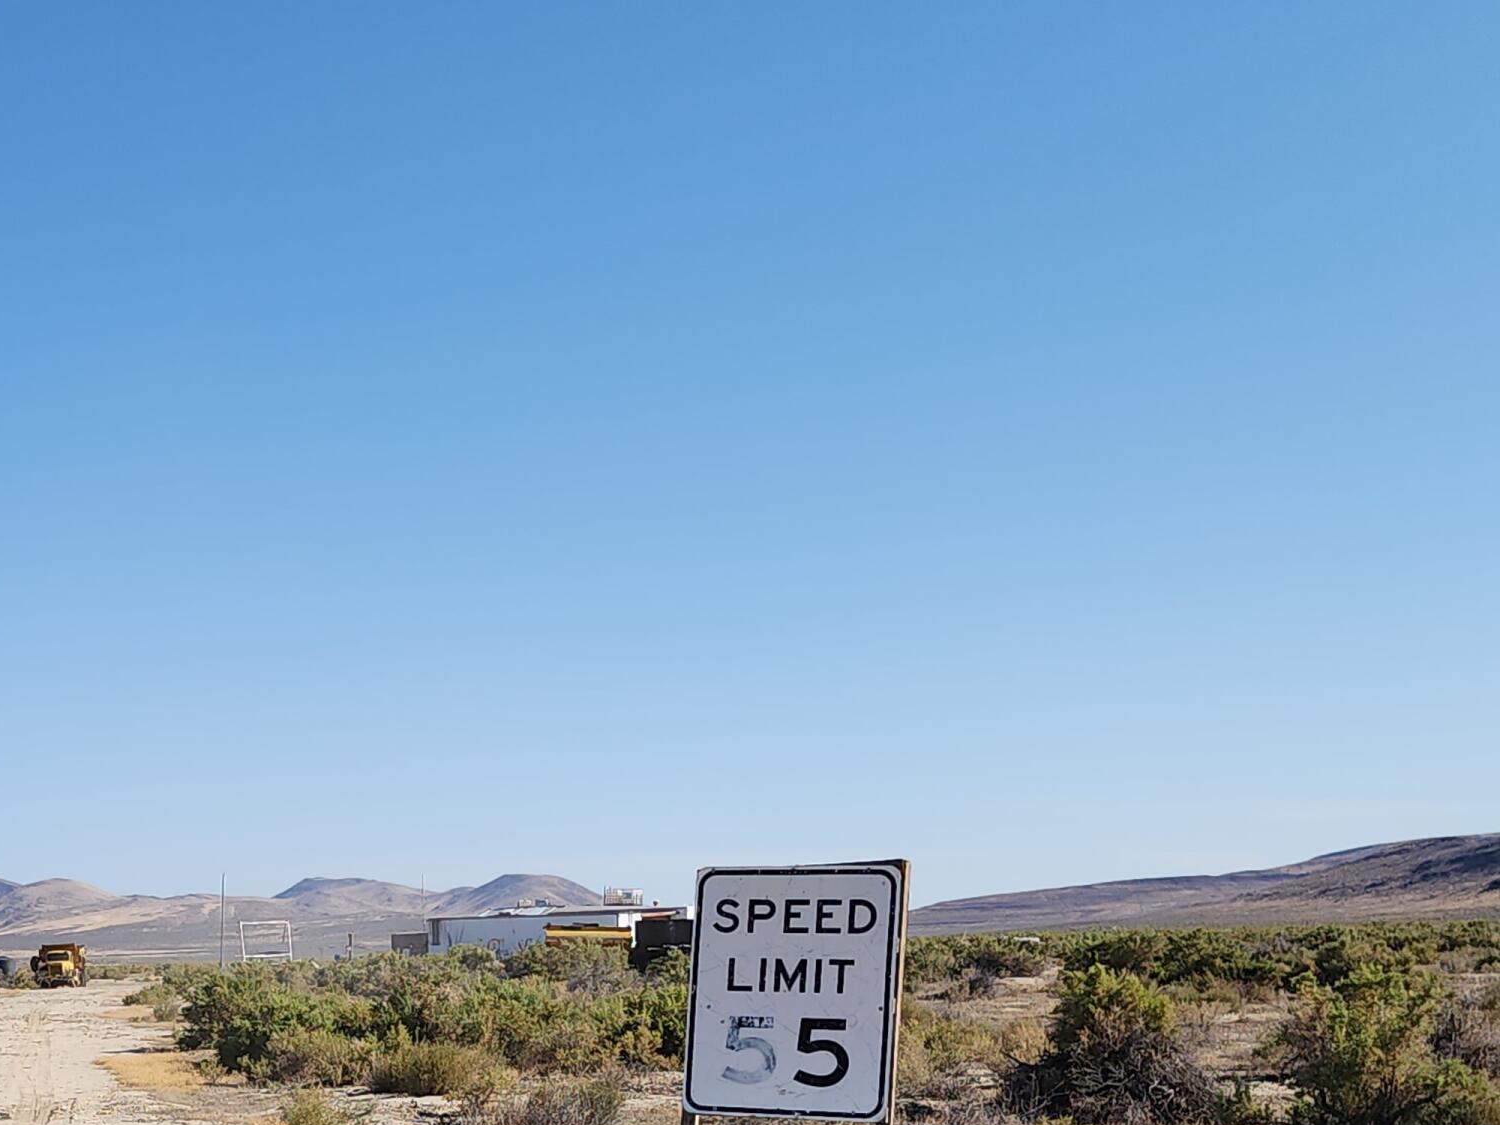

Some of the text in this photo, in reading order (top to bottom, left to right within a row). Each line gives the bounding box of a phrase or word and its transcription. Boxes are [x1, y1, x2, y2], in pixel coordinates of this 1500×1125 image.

[713, 898, 877, 933] SPEED
[726, 957, 855, 994] LIMIT
[722, 1016, 850, 1087] 55
